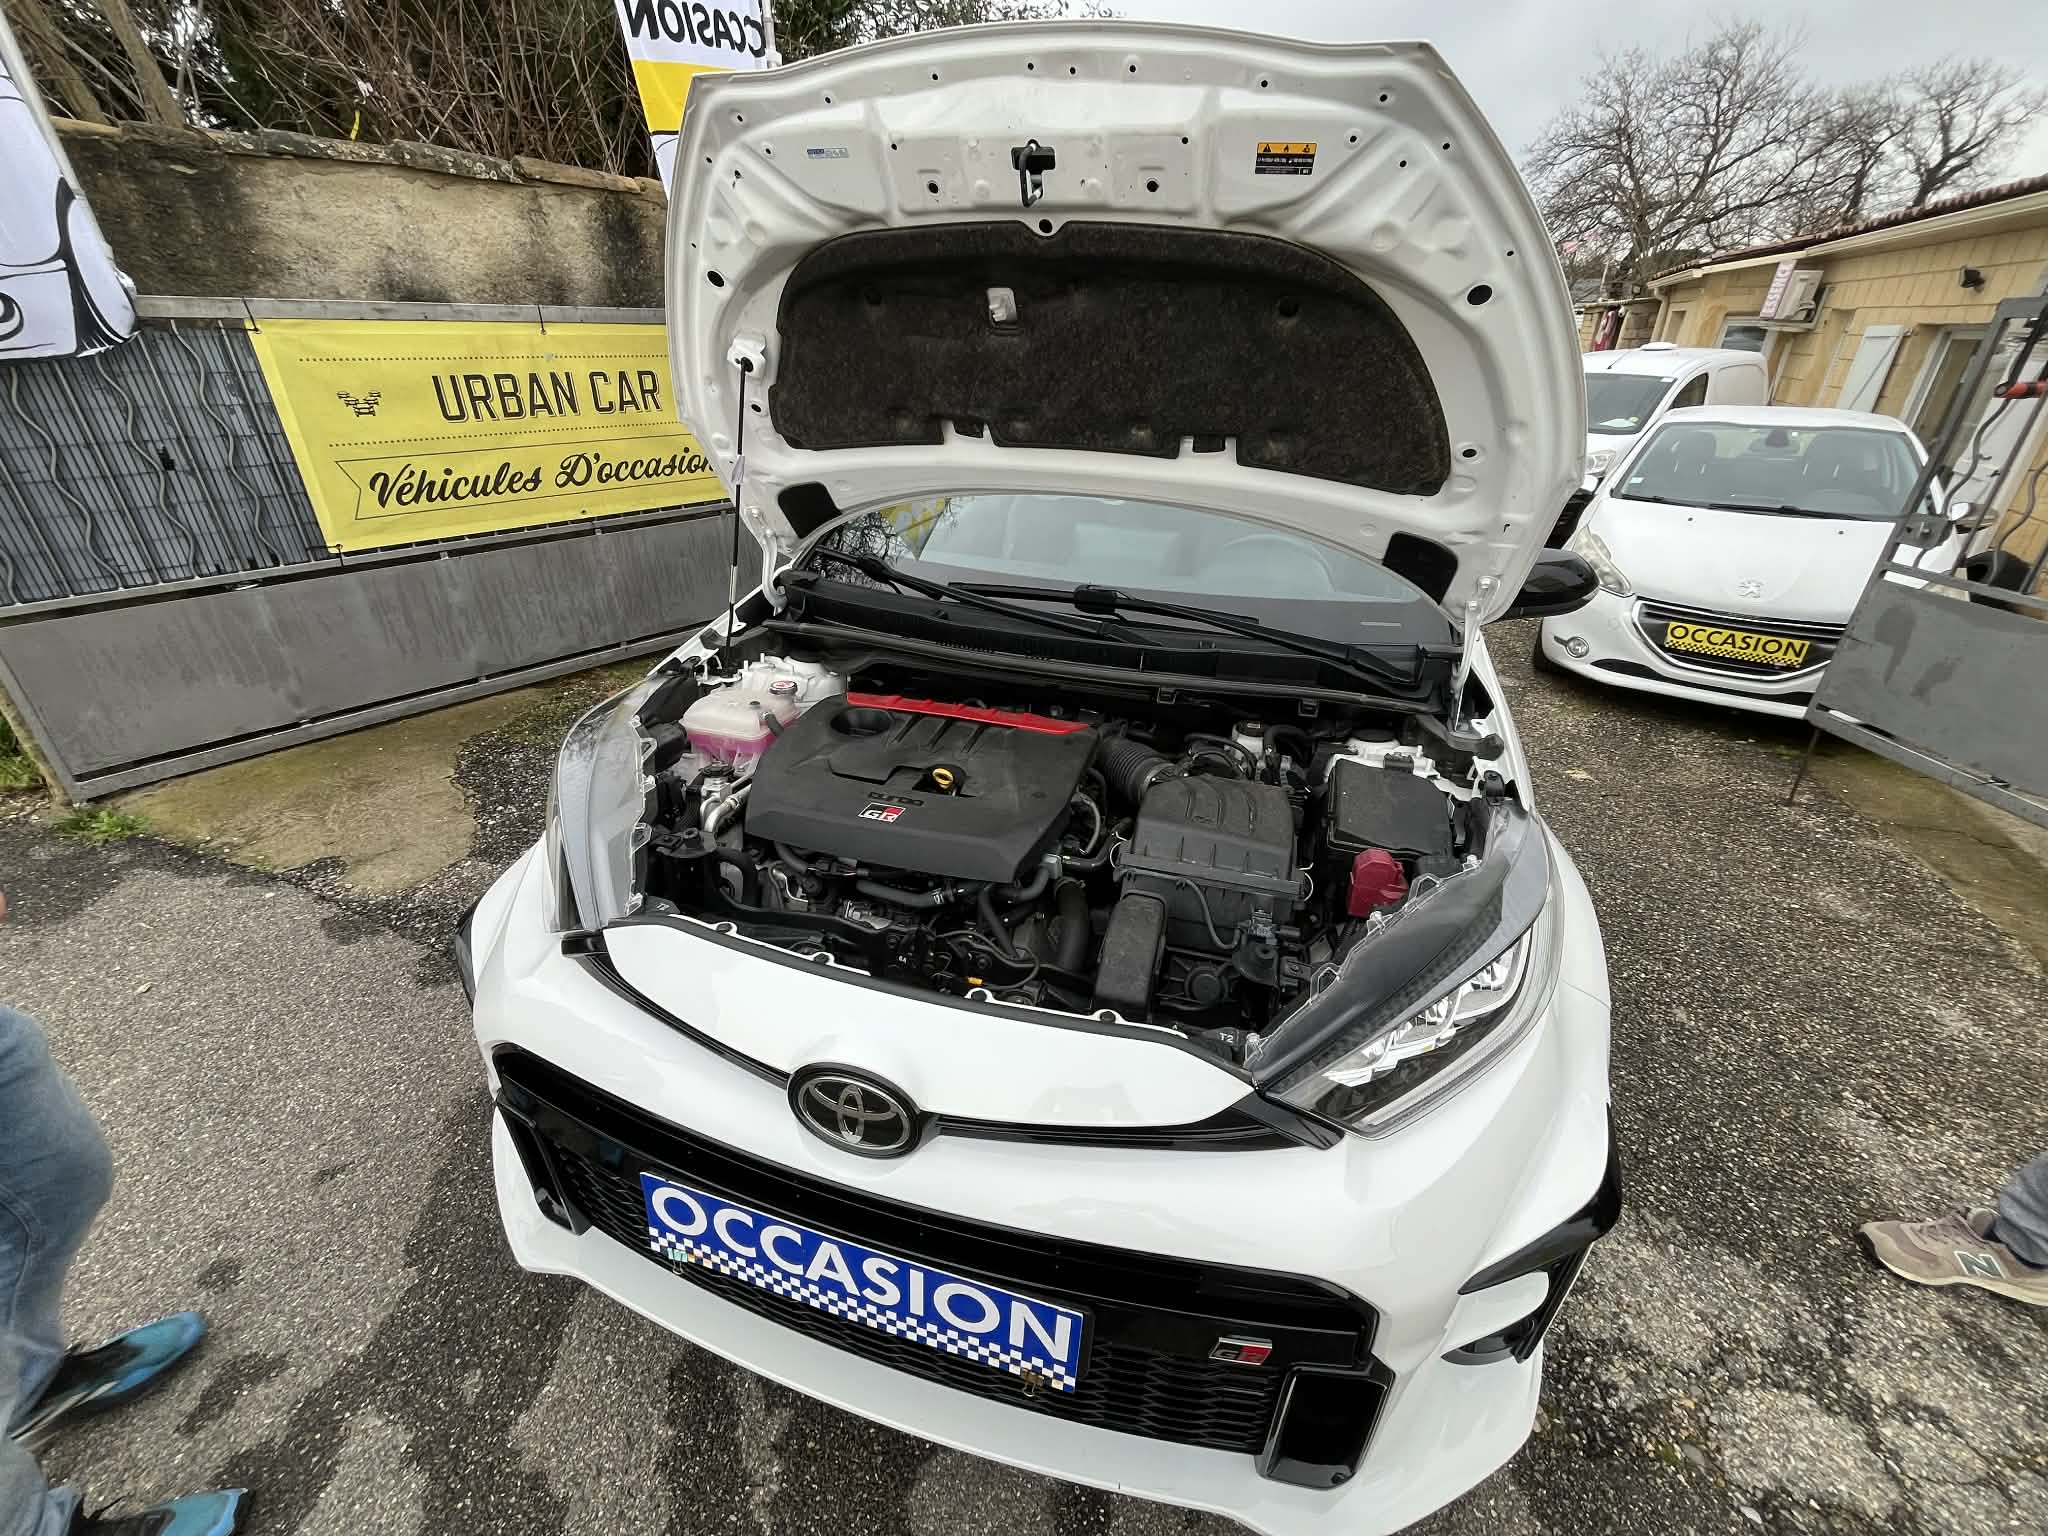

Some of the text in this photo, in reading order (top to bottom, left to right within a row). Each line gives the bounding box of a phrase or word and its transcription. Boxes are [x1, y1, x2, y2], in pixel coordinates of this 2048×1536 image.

[432, 370, 663, 421] URBAN CAR
[369, 462, 543, 508] Véhicules
[1670, 625, 1806, 658] OCCASION
[651, 1186, 1073, 1363] OCCASION
